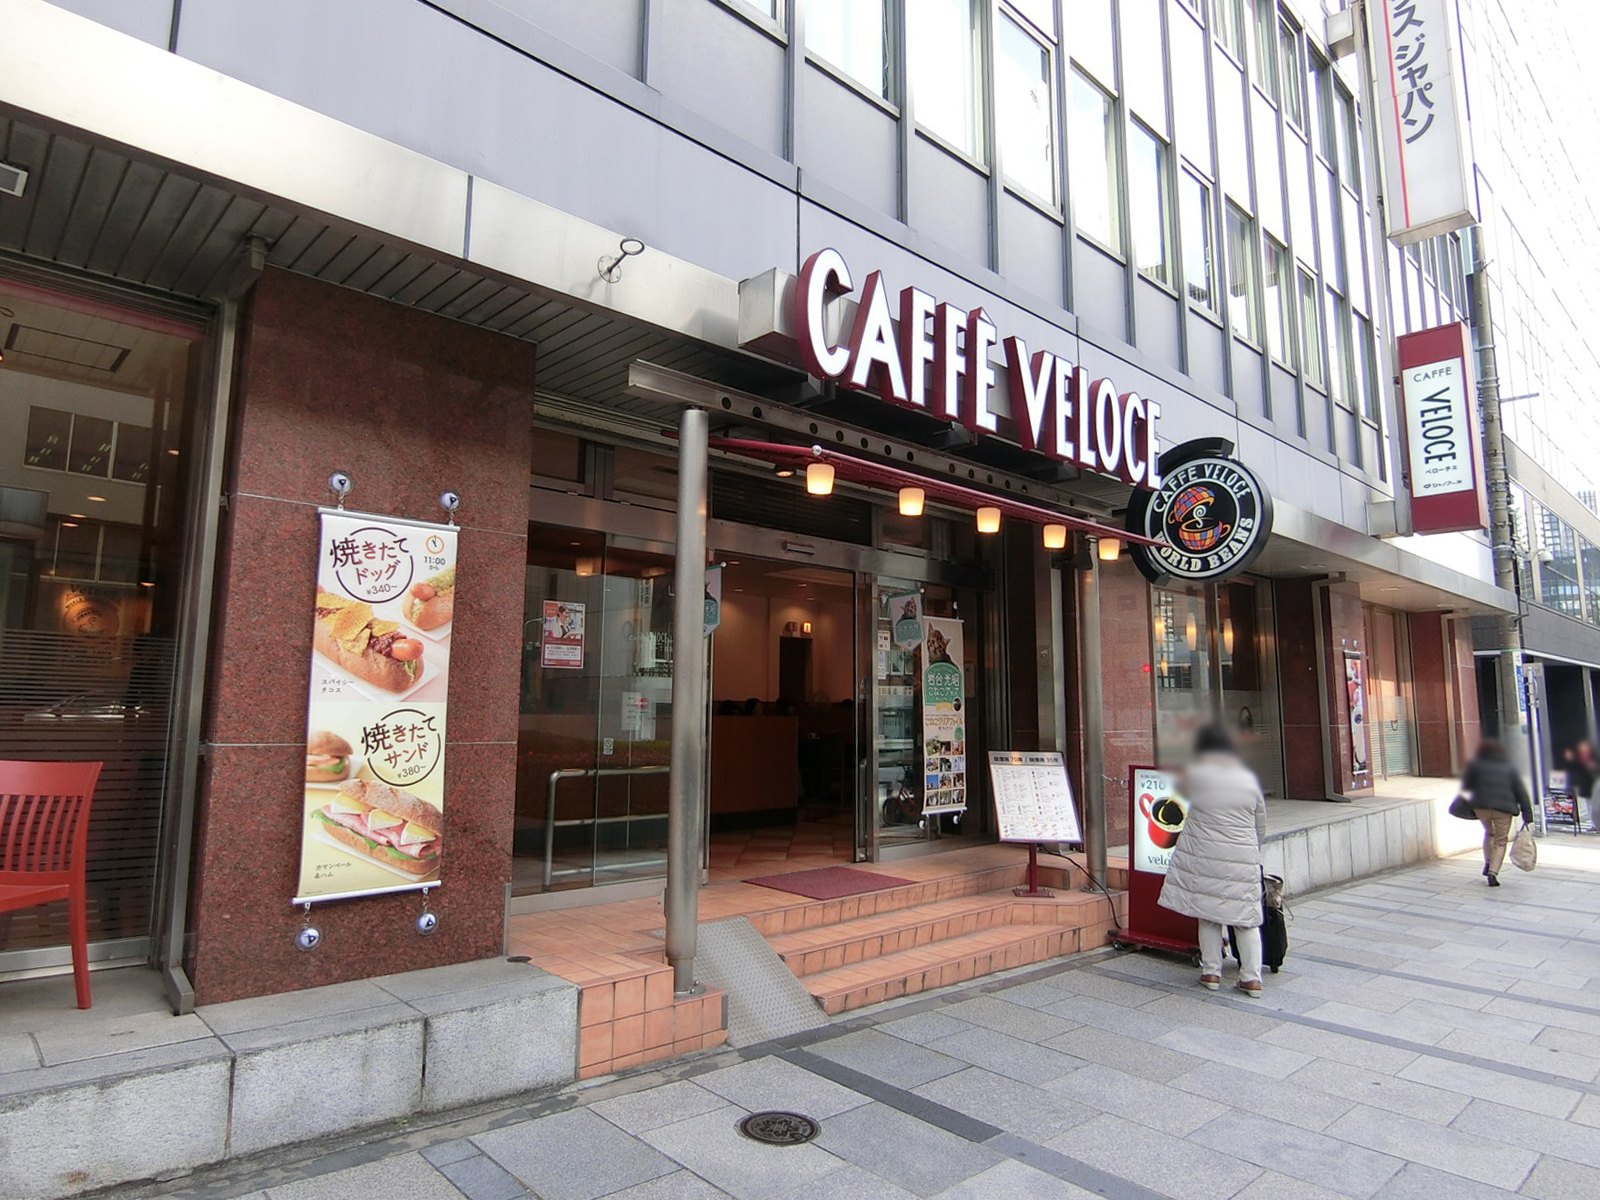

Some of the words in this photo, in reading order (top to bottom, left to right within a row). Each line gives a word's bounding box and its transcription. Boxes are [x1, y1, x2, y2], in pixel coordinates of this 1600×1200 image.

[1413, 366, 1452, 383] CAFFE
[1003, 335, 1162, 491] VELOCE
[1420, 386, 1457, 465] VELOCE
[1153, 466, 1198, 513] CAFFE
[1204, 464, 1252, 499] VELOCE
[329, 536, 410, 569] 焼きたて
[1207, 517, 1254, 569] BEANS
[354, 559, 402, 586] ドッグ
[423, 555, 446, 566] 11:00
[360, 715, 437, 757] 焼きたて
[383, 742, 429, 769] サンド
[316, 862, 352, 871] カマンベール
